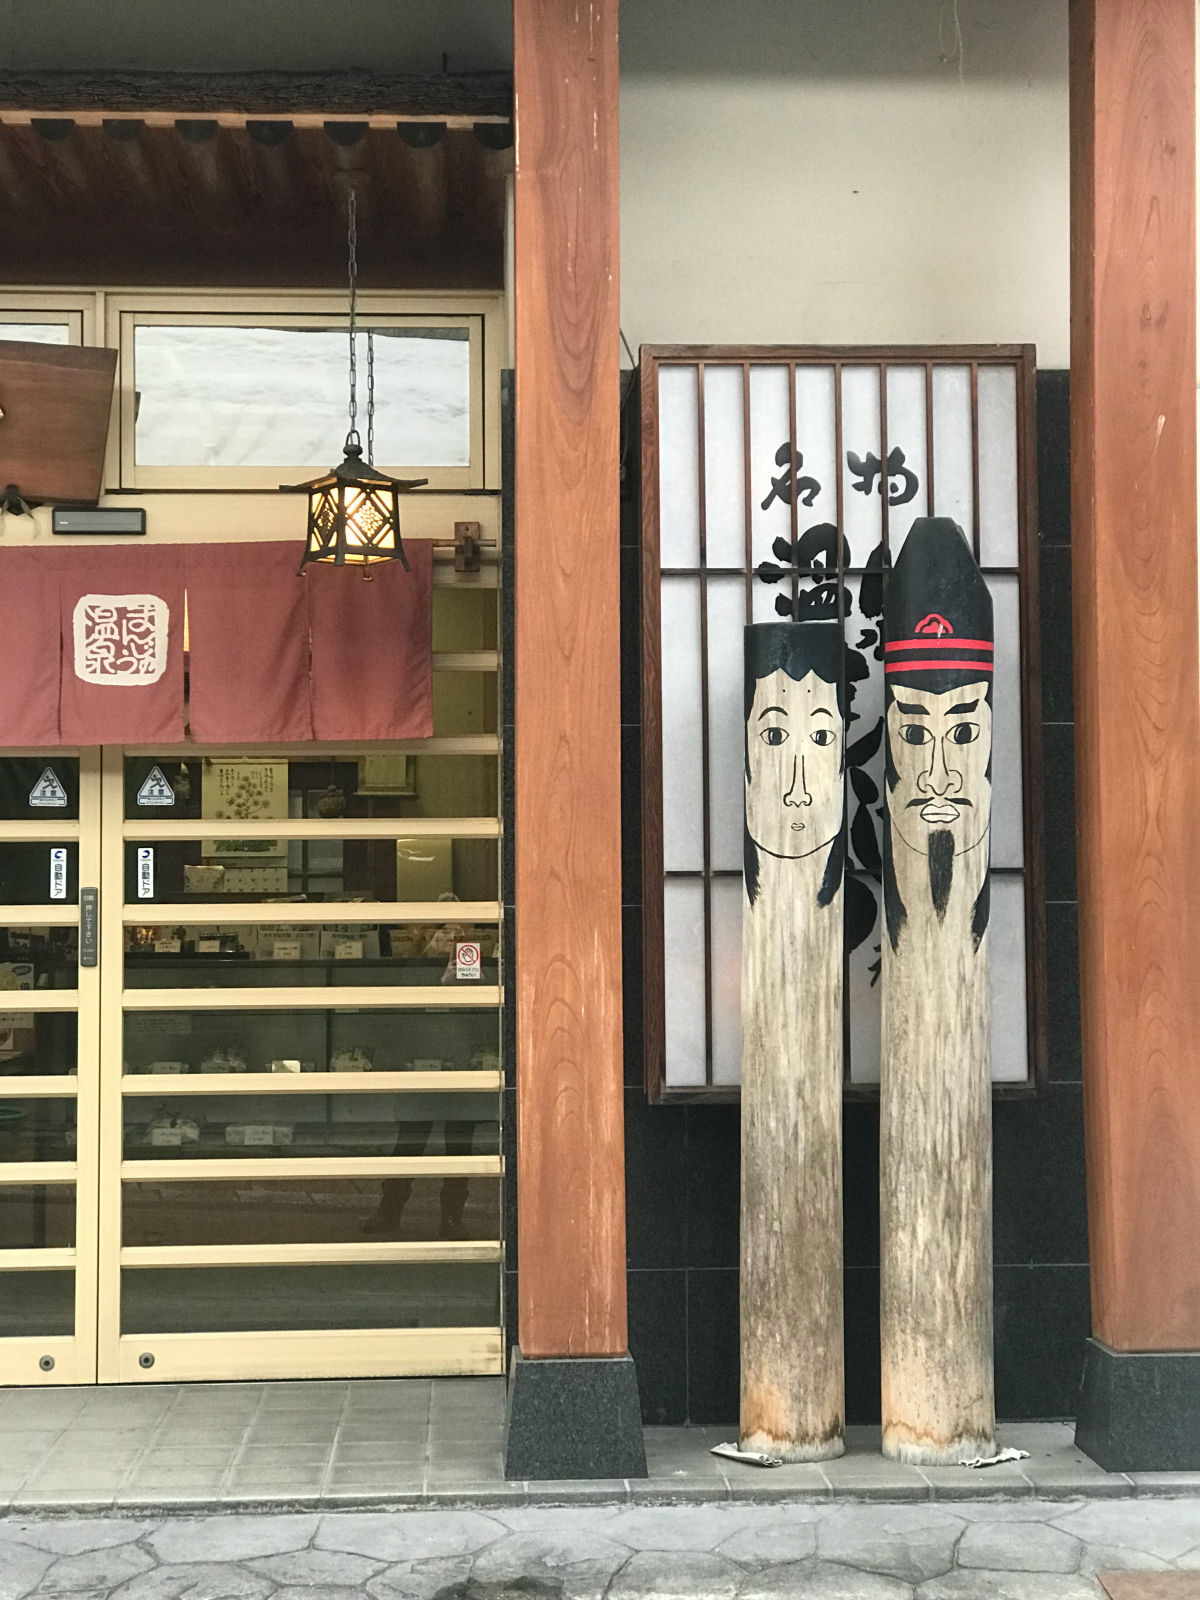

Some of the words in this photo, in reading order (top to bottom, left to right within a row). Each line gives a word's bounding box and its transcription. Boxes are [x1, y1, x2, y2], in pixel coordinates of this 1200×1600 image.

[761, 441, 919, 511] 名物
[54, 863, 63, 897] 自動ドア
[141, 863, 151, 896] 自動ドア
[85, 904, 93, 944] 押して下さい
